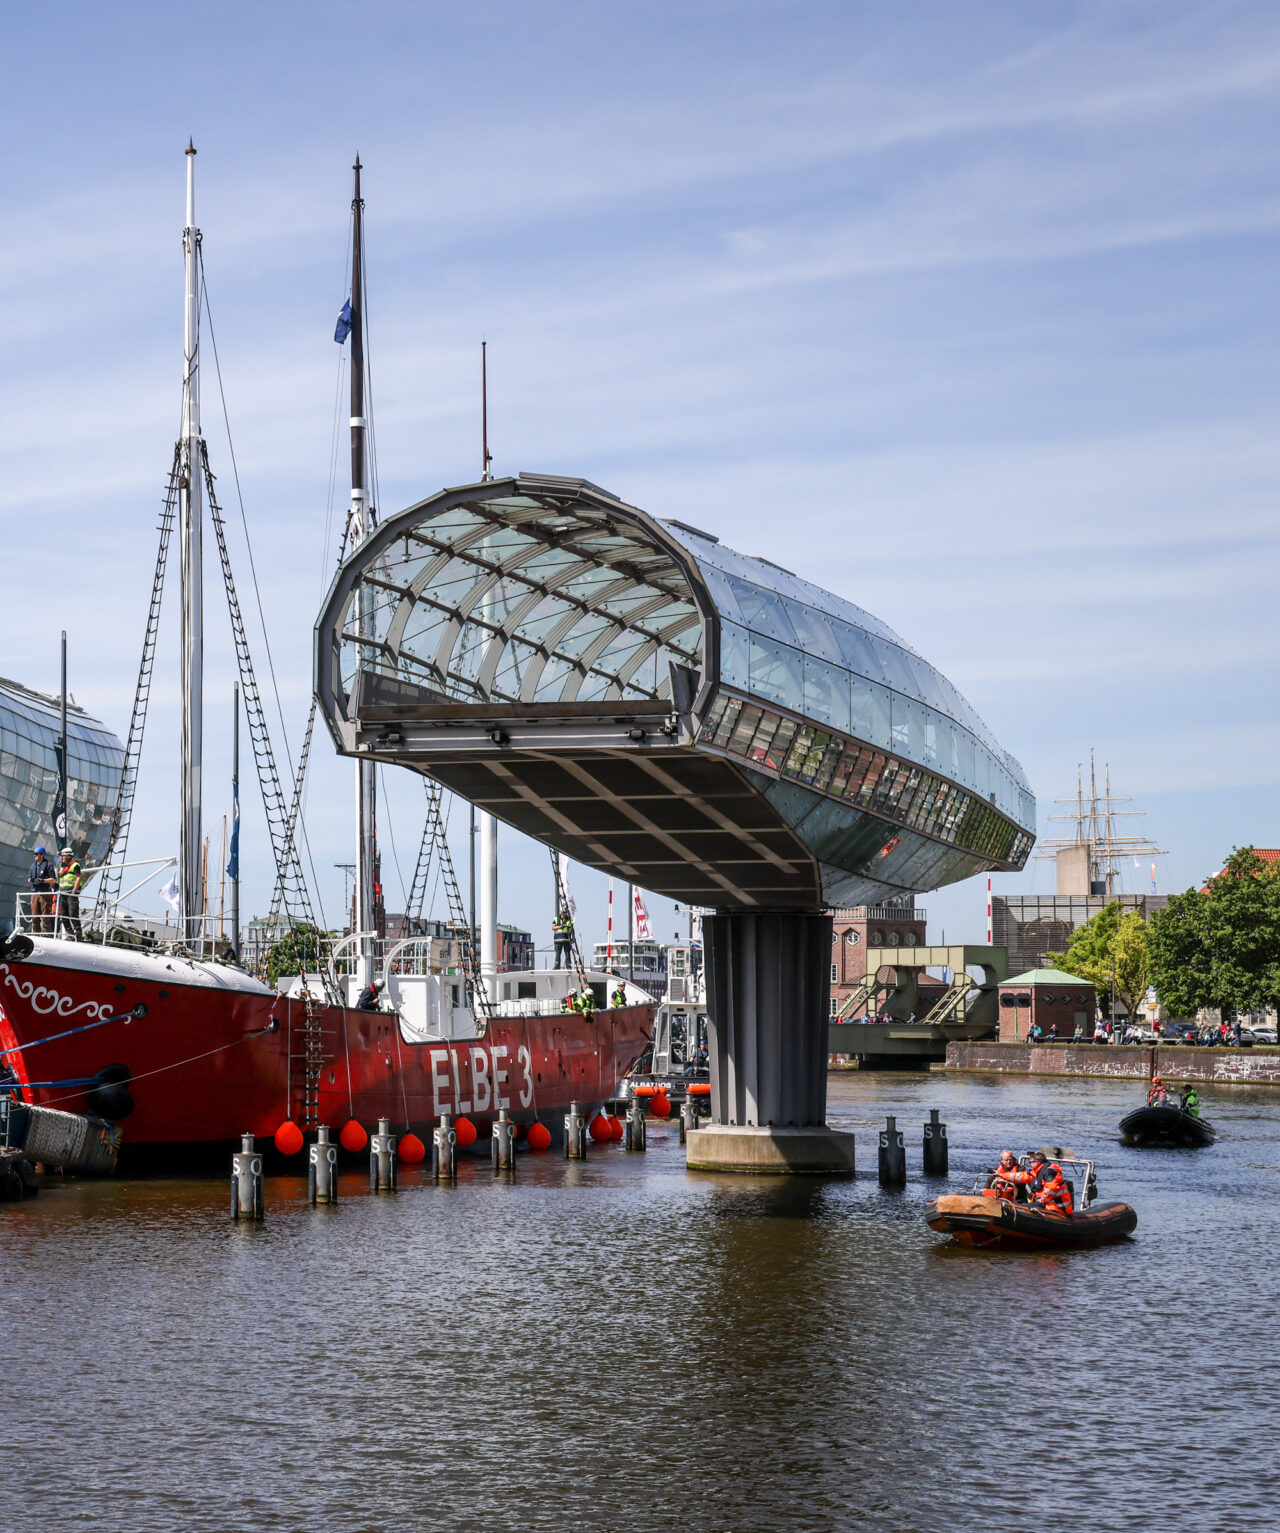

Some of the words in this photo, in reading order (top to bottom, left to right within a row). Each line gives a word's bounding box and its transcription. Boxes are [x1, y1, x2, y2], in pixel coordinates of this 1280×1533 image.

[430, 1046, 510, 1117] ELBE
[518, 1045, 533, 1109] 3
[626, 1111, 633, 1122] S
[680, 1105, 686, 1117] S
[564, 1116, 570, 1129] S
[434, 1130, 440, 1144] S
[493, 1124, 500, 1137] S
[925, 1126, 933, 1139] S
[371, 1138, 380, 1153] S
[881, 1134, 889, 1148] S
[309, 1147, 318, 1163] S
[233, 1157, 240, 1175] S
